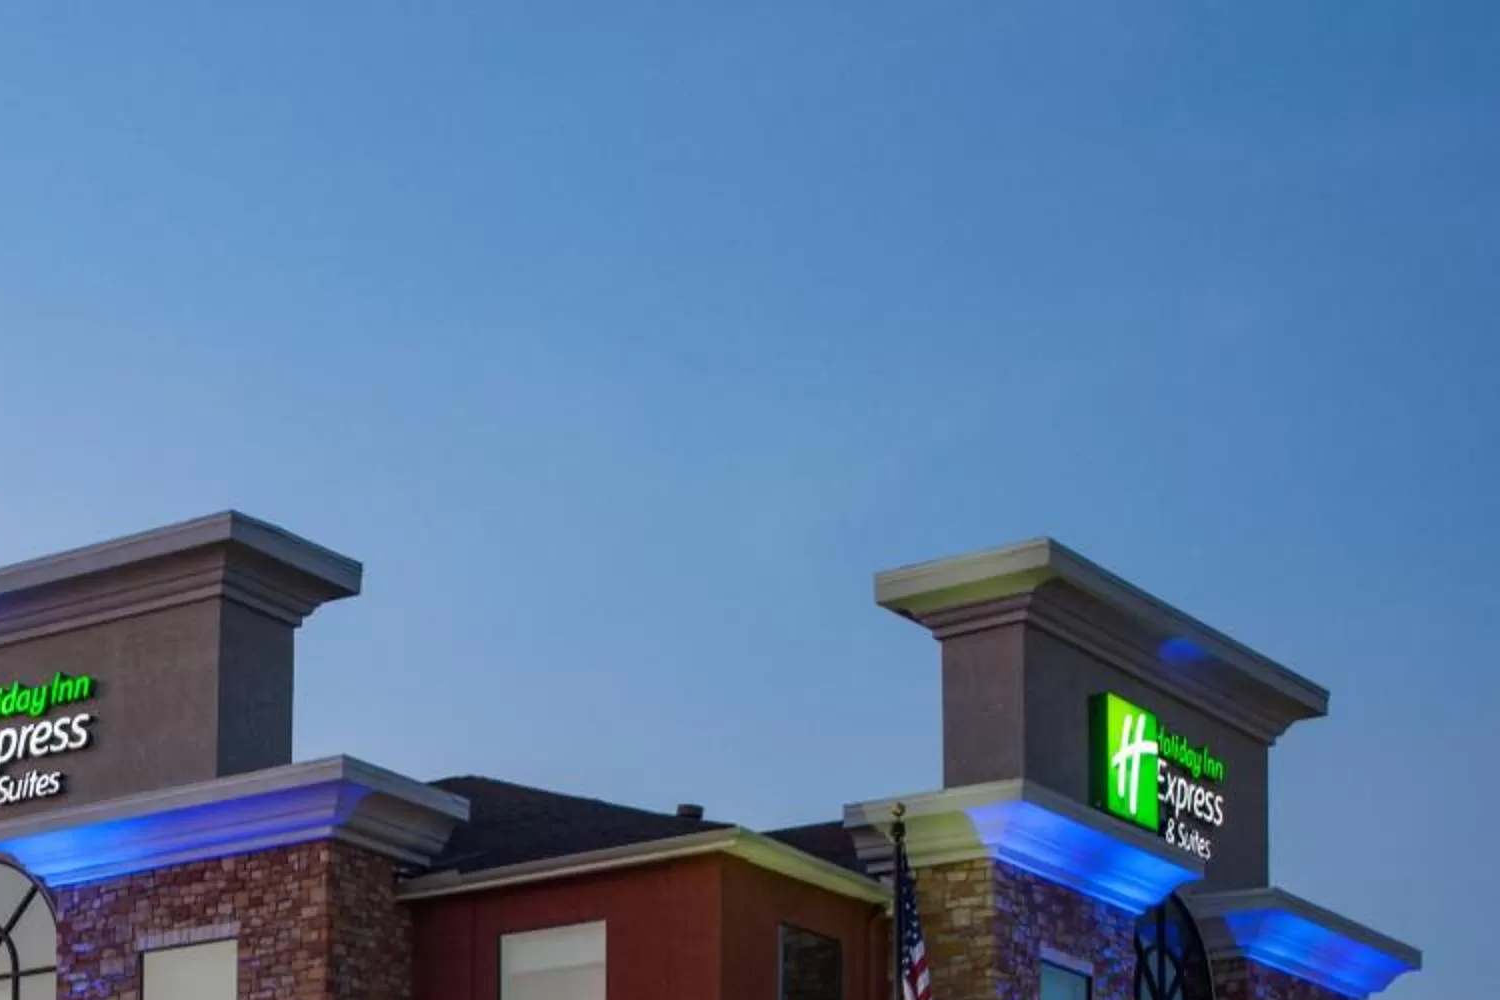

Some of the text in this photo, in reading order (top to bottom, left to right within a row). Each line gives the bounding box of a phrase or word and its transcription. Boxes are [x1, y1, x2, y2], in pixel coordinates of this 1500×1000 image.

[51, 671, 92, 703] Inn
[1203, 746, 1223, 782] Inn
[1157, 759, 1224, 826] Express
[1165, 818, 1212, 860] & Suites
